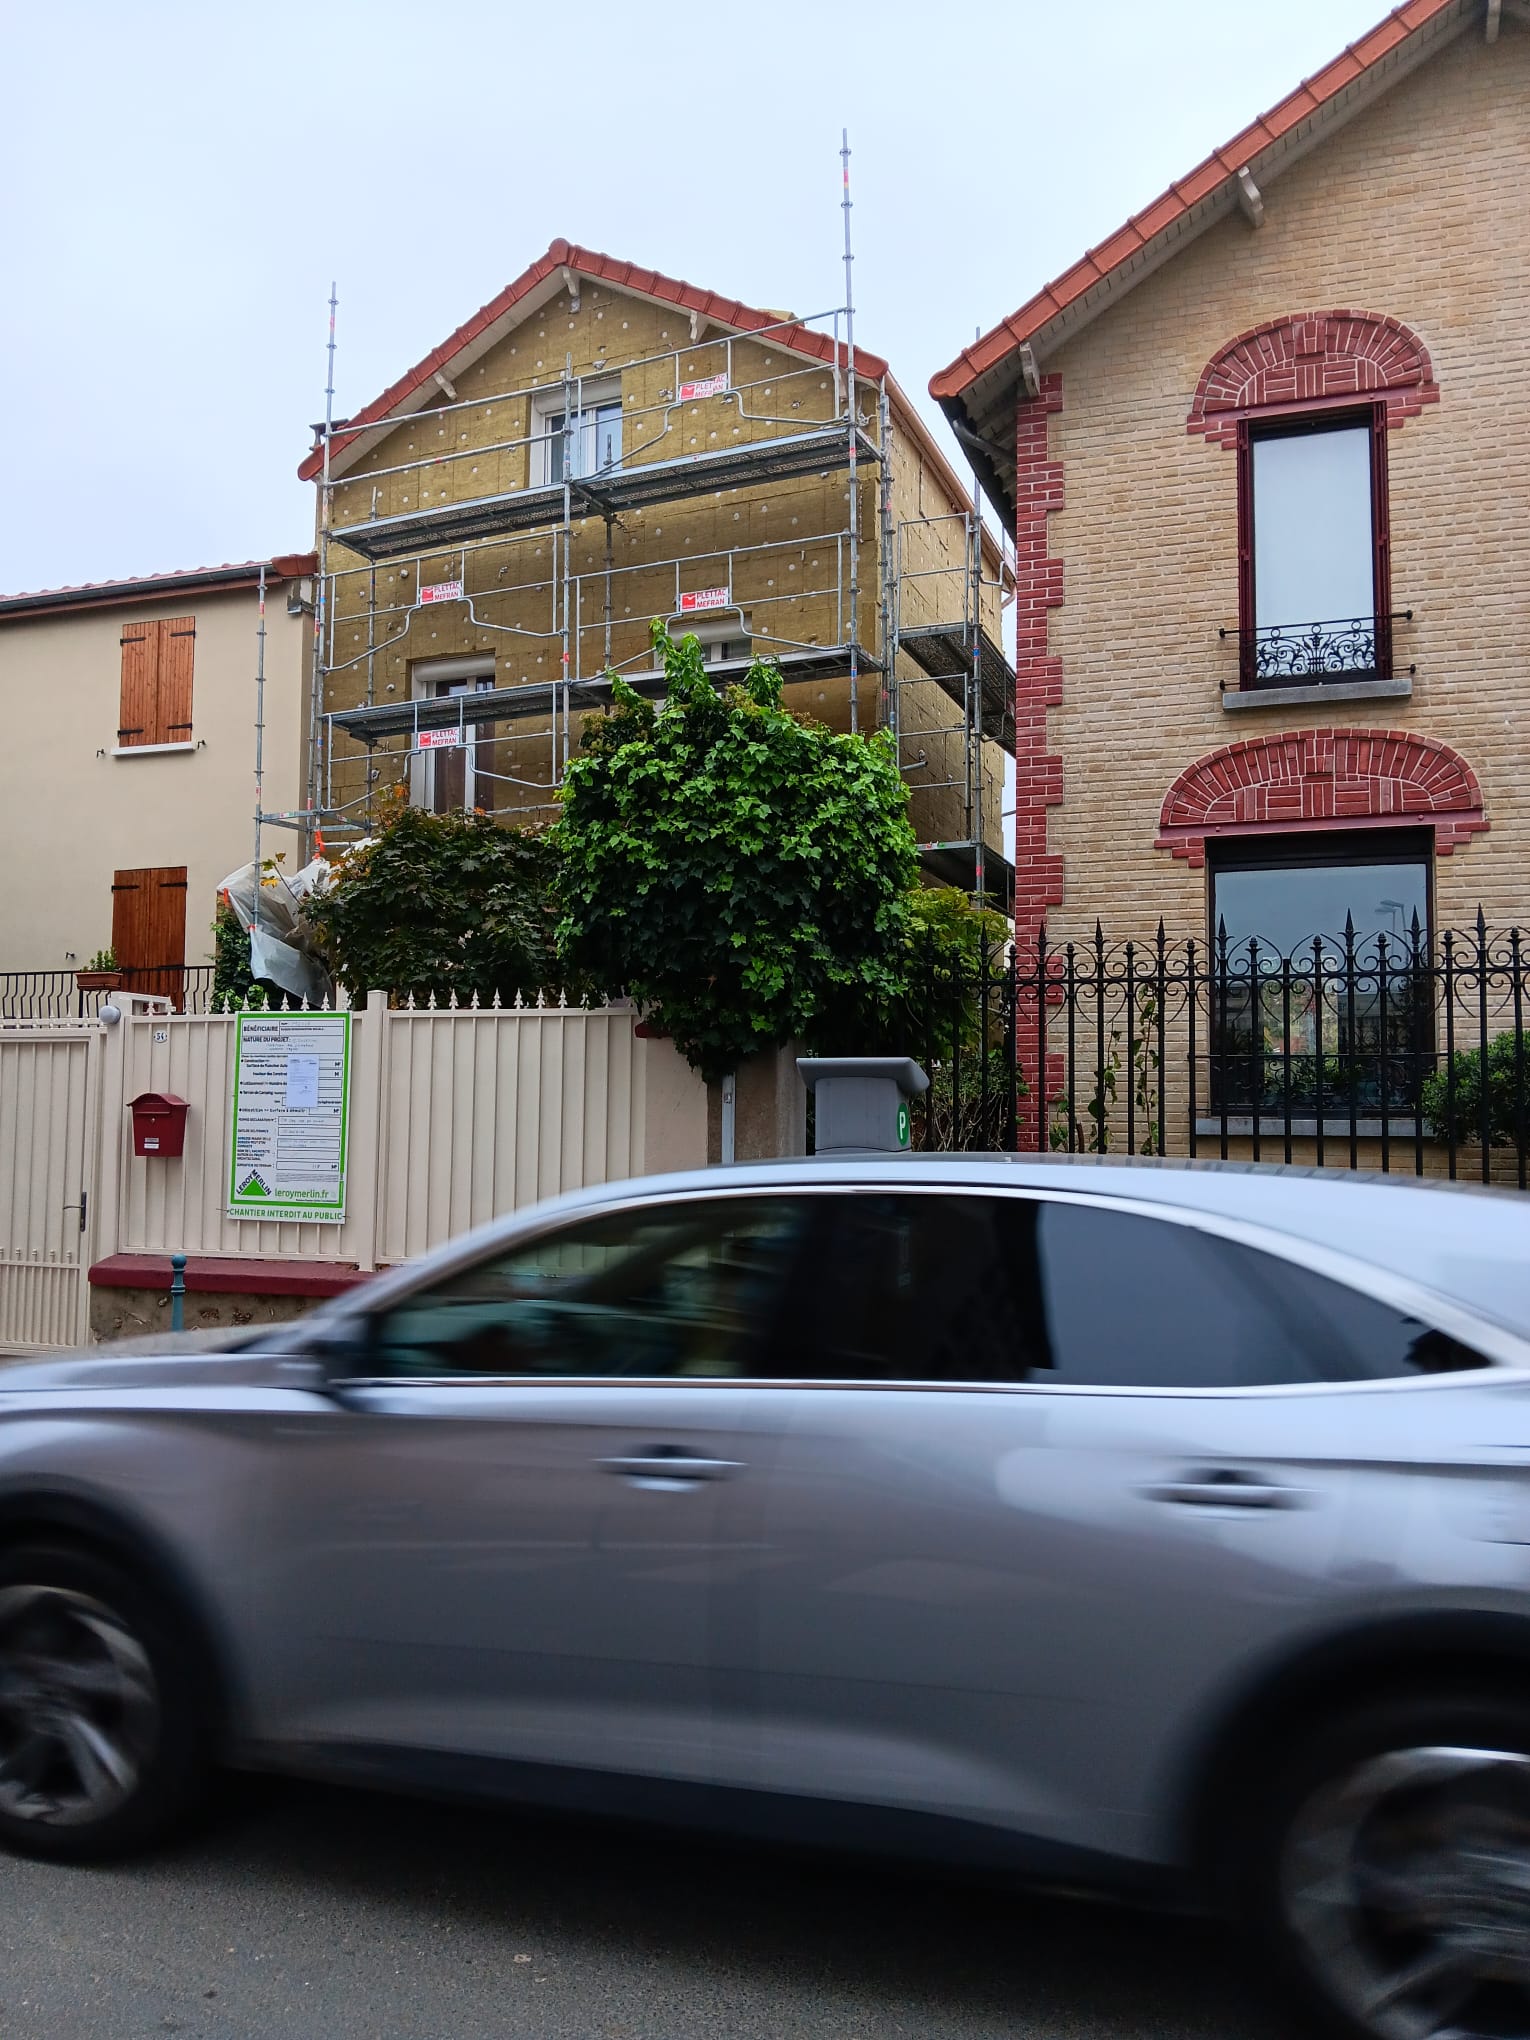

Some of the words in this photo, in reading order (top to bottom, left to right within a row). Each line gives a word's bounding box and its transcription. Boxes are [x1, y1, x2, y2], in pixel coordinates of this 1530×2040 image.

[434, 582, 460, 592] PLETTAC
[435, 592, 458, 600] MEFRAN
[697, 588, 726, 599] PLETTAC
[697, 598, 724, 608] MEFRAN
[432, 729, 458, 737] PLETTAC
[432, 737, 457, 746] MEFRAN
[236, 1174, 253, 1195] LEROY
[252, 1169, 272, 1196] MERLIN
[274, 1188, 329, 1199] leroymerlin.fr
[229, 1208, 266, 1217] CHANTIER
[267, 1210, 300, 1218] INTERDIT
